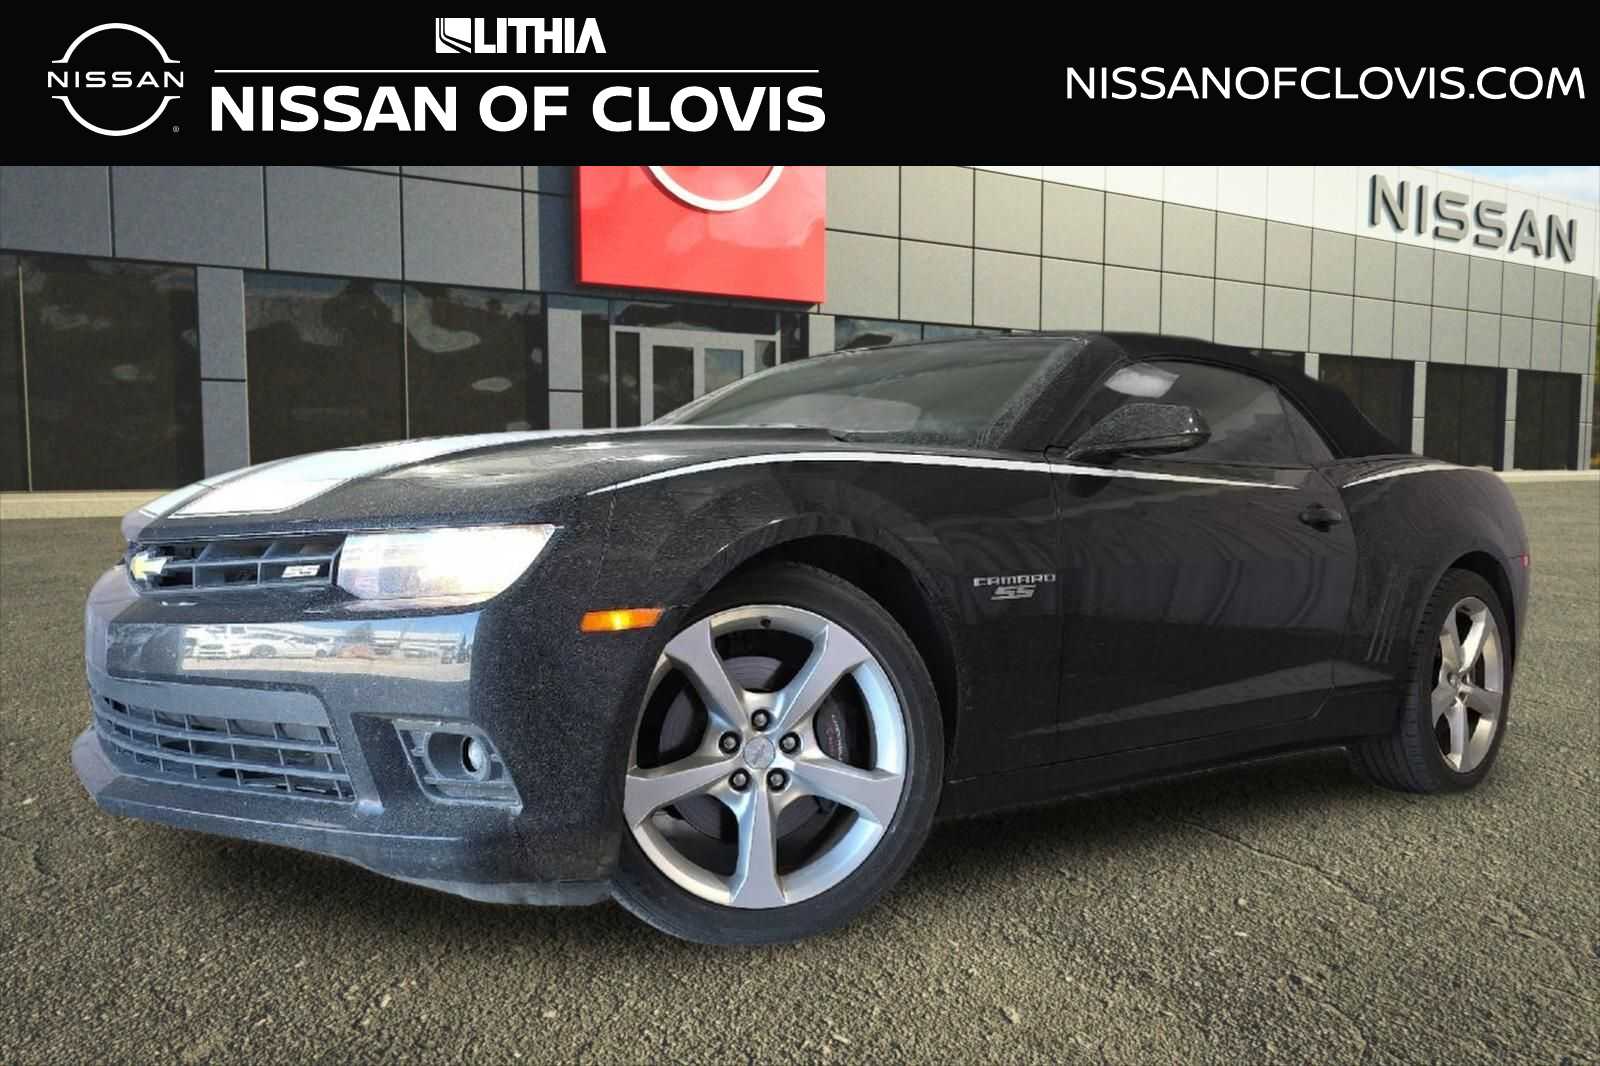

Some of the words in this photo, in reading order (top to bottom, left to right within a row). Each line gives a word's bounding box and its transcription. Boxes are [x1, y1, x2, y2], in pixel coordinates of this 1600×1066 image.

[1369, 174, 1577, 262] NISSAN
[973, 573, 1057, 587] CAMARO
[990, 584, 1037, 600] SS
